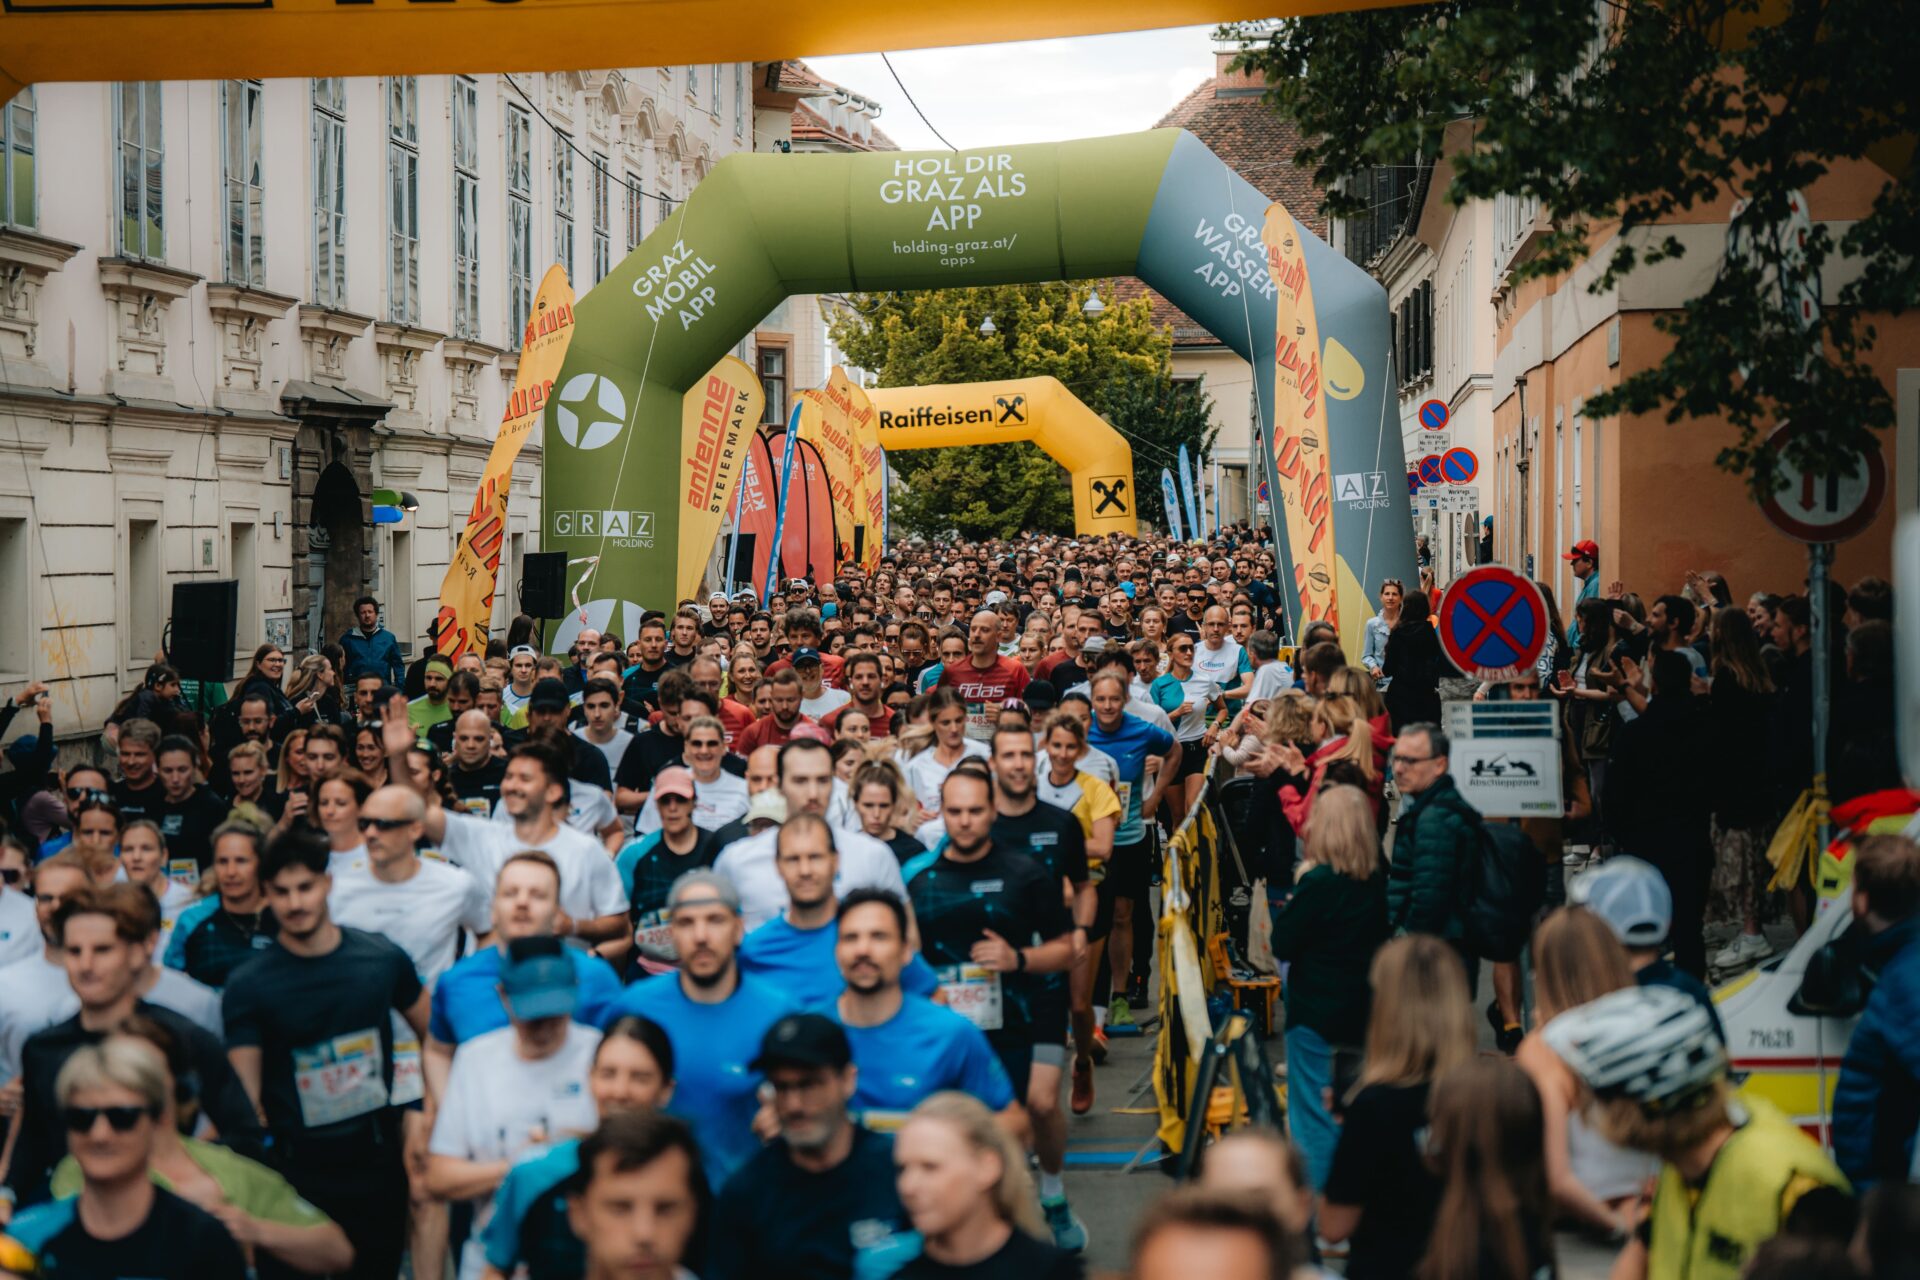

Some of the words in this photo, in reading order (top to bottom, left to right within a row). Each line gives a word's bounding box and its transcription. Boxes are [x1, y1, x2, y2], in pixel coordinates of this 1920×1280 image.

[894, 158, 956, 177] HOL
[965, 154, 1013, 174] DIR
[879, 176, 966, 204] GRAZ
[973, 173, 1027, 199] ALS
[926, 204, 982, 231] APP
[893, 233, 1017, 255] holding-graz.at/
[1224, 213, 1269, 263] GRA
[632, 239, 694, 297] GRAZ
[940, 256, 976, 268] apps
[1194, 217, 1278, 300] WASSER
[645, 257, 716, 322] MOBIL
[1193, 262, 1241, 297] APP
[679, 286, 716, 331] APP
[879, 405, 993, 429] Raiffeisen
[687, 375, 729, 510] antenne
[711, 390, 749, 513] STEIERMARK
[1349, 498, 1390, 510] HOLDING
[555, 511, 653, 537] GRAZ
[613, 538, 654, 549] HOLDING
[1475, 664, 1520, 681] ANFANG
[1470, 778, 1540, 788] Abschleppzone
